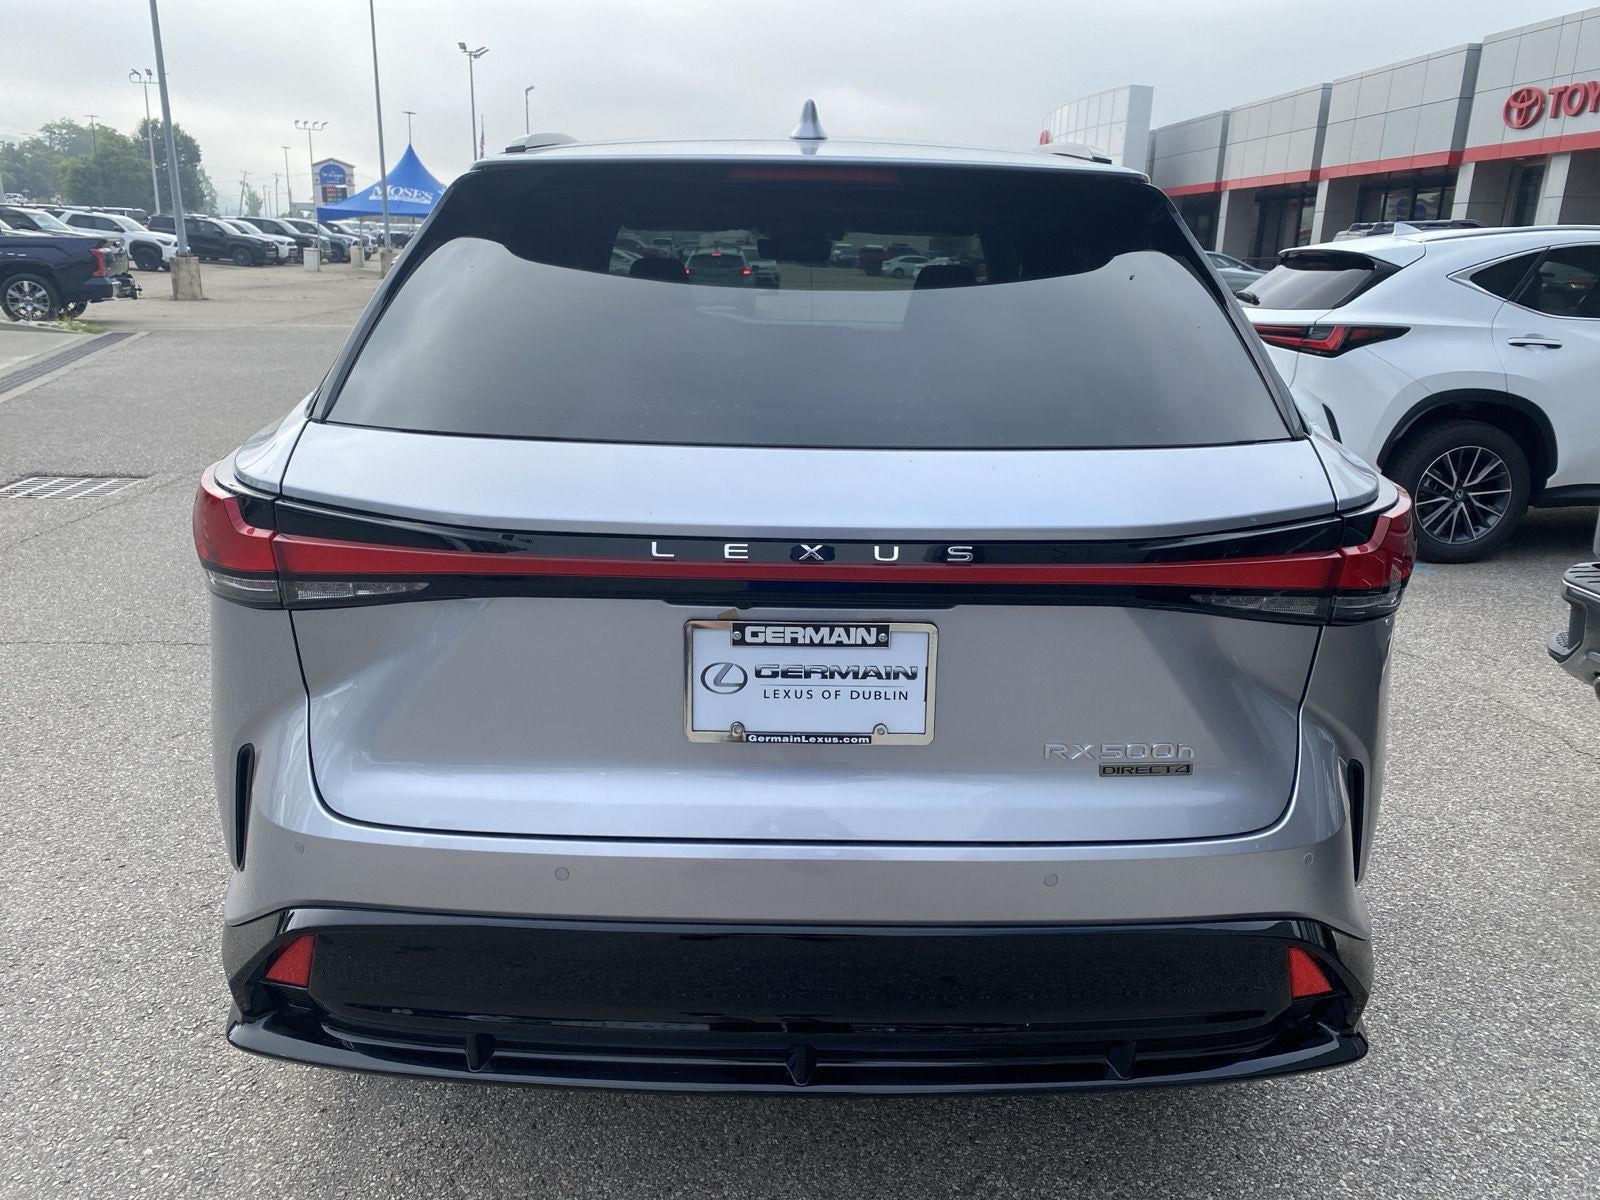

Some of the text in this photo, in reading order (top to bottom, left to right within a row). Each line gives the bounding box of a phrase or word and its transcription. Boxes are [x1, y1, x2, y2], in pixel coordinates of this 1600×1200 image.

[651, 541, 974, 562] LEXUS
[744, 626, 876, 644] GERMAIN
[754, 664, 918, 680] GERMAIN
[763, 689, 909, 701] LEXUS OF DUBLIN
[748, 734, 870, 744] GermainLexus.com
[1102, 764, 1191, 775] DIRECT4
